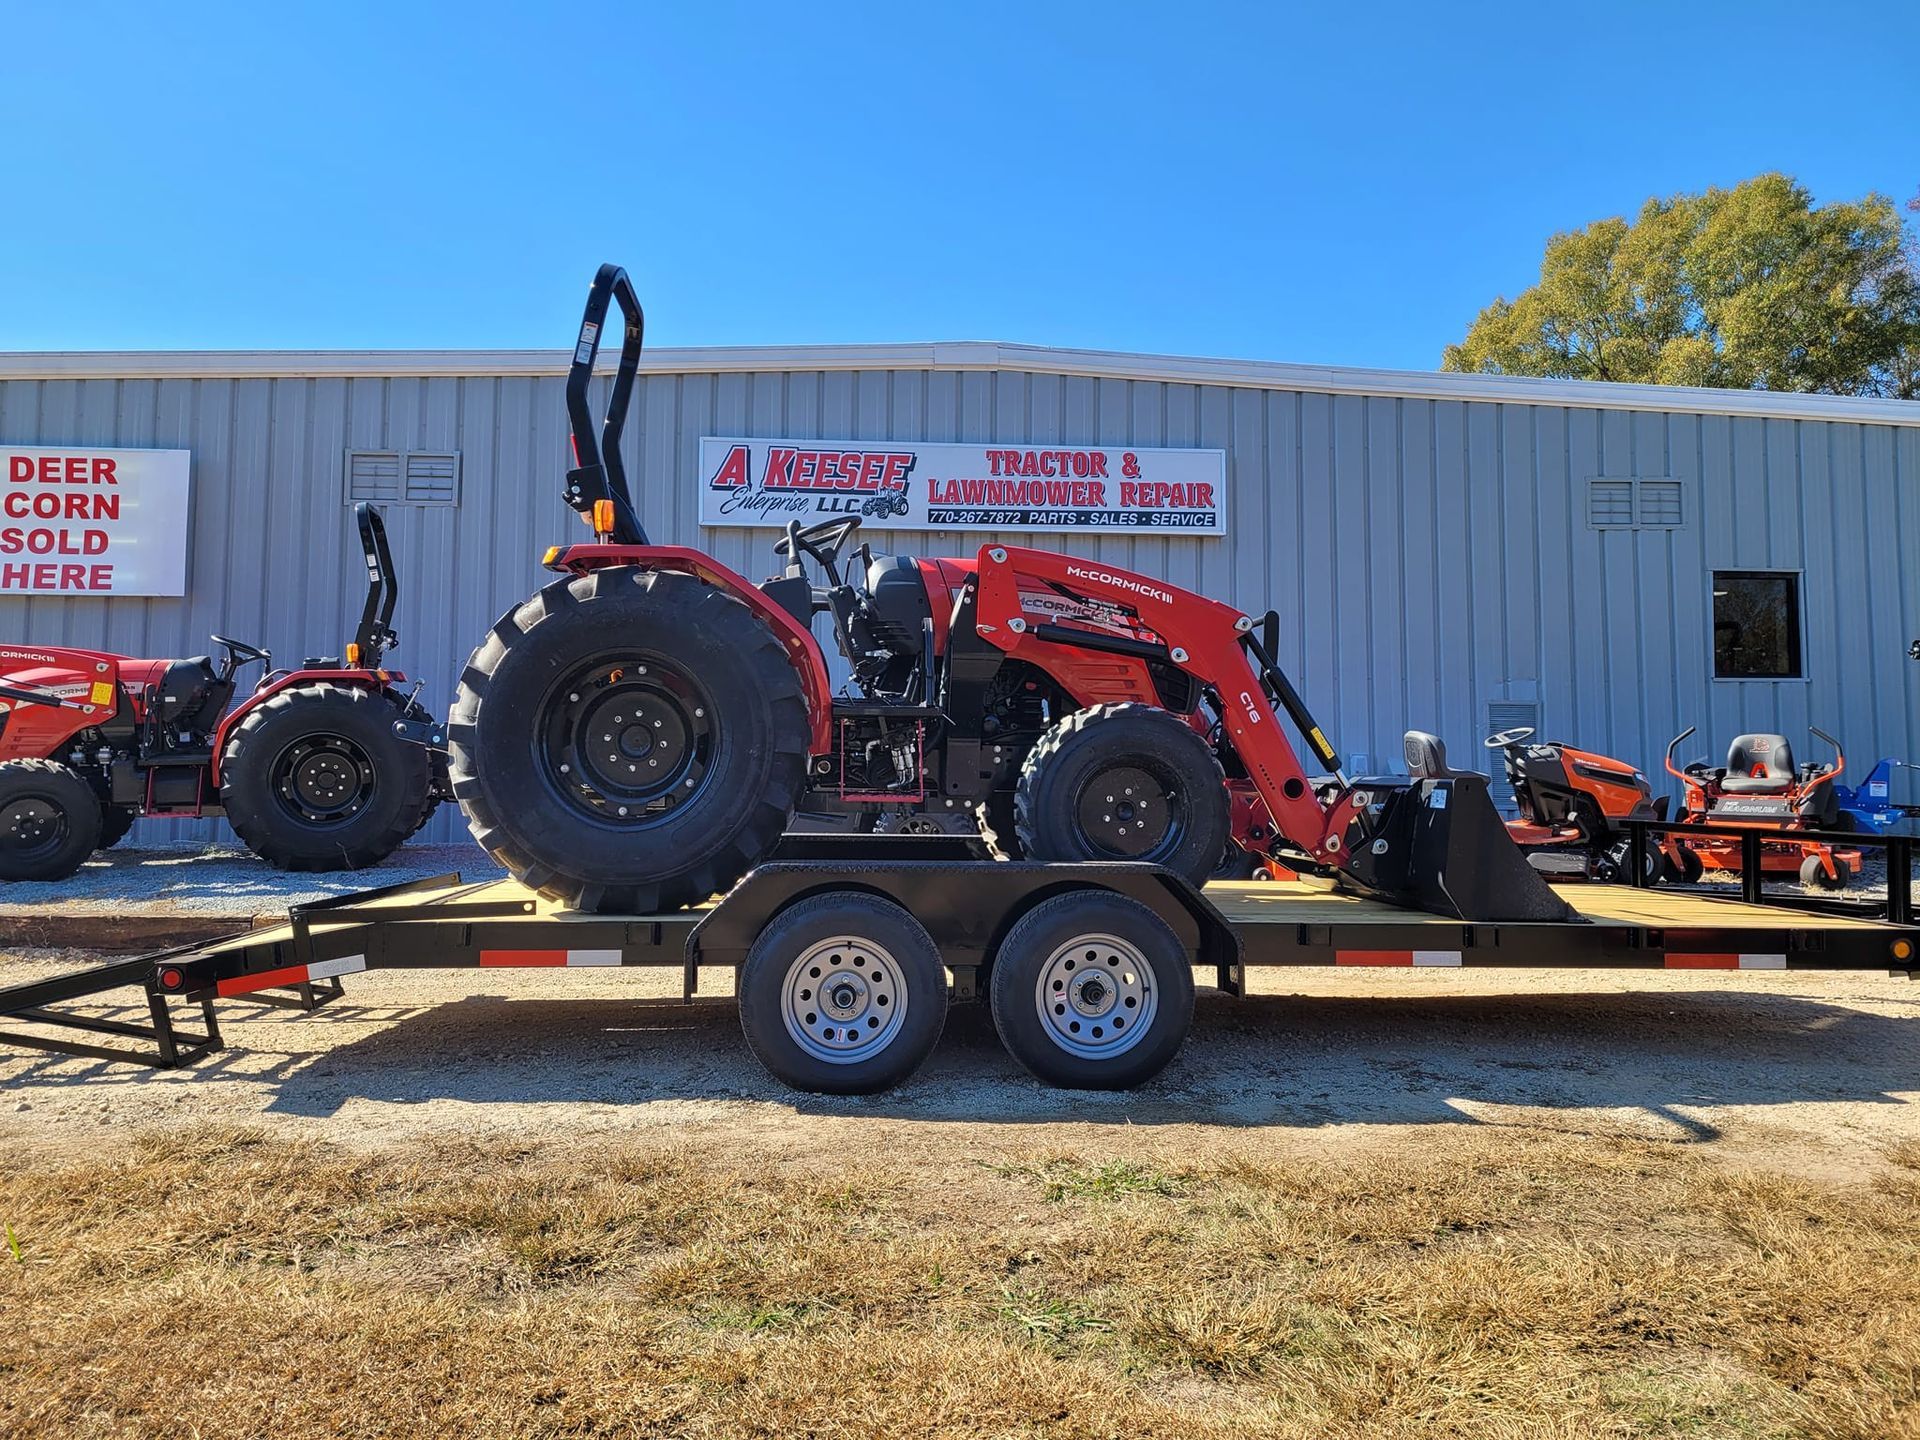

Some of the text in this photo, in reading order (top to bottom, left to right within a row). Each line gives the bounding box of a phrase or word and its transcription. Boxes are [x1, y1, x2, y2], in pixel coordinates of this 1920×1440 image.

[9, 456, 118, 485] DEER
[710, 444, 917, 496] A KEESEE
[986, 450, 1141, 478] TRACTOR &
[4, 493, 120, 520] CORN
[928, 479, 1216, 508] LAWNMOWER REPAIR
[929, 511, 1214, 526] 770-267-7872 PARTS SALES SERVICE
[0, 528, 109, 556] SOLD
[2, 563, 113, 591] HERE
[1240, 692, 1261, 723] C16
